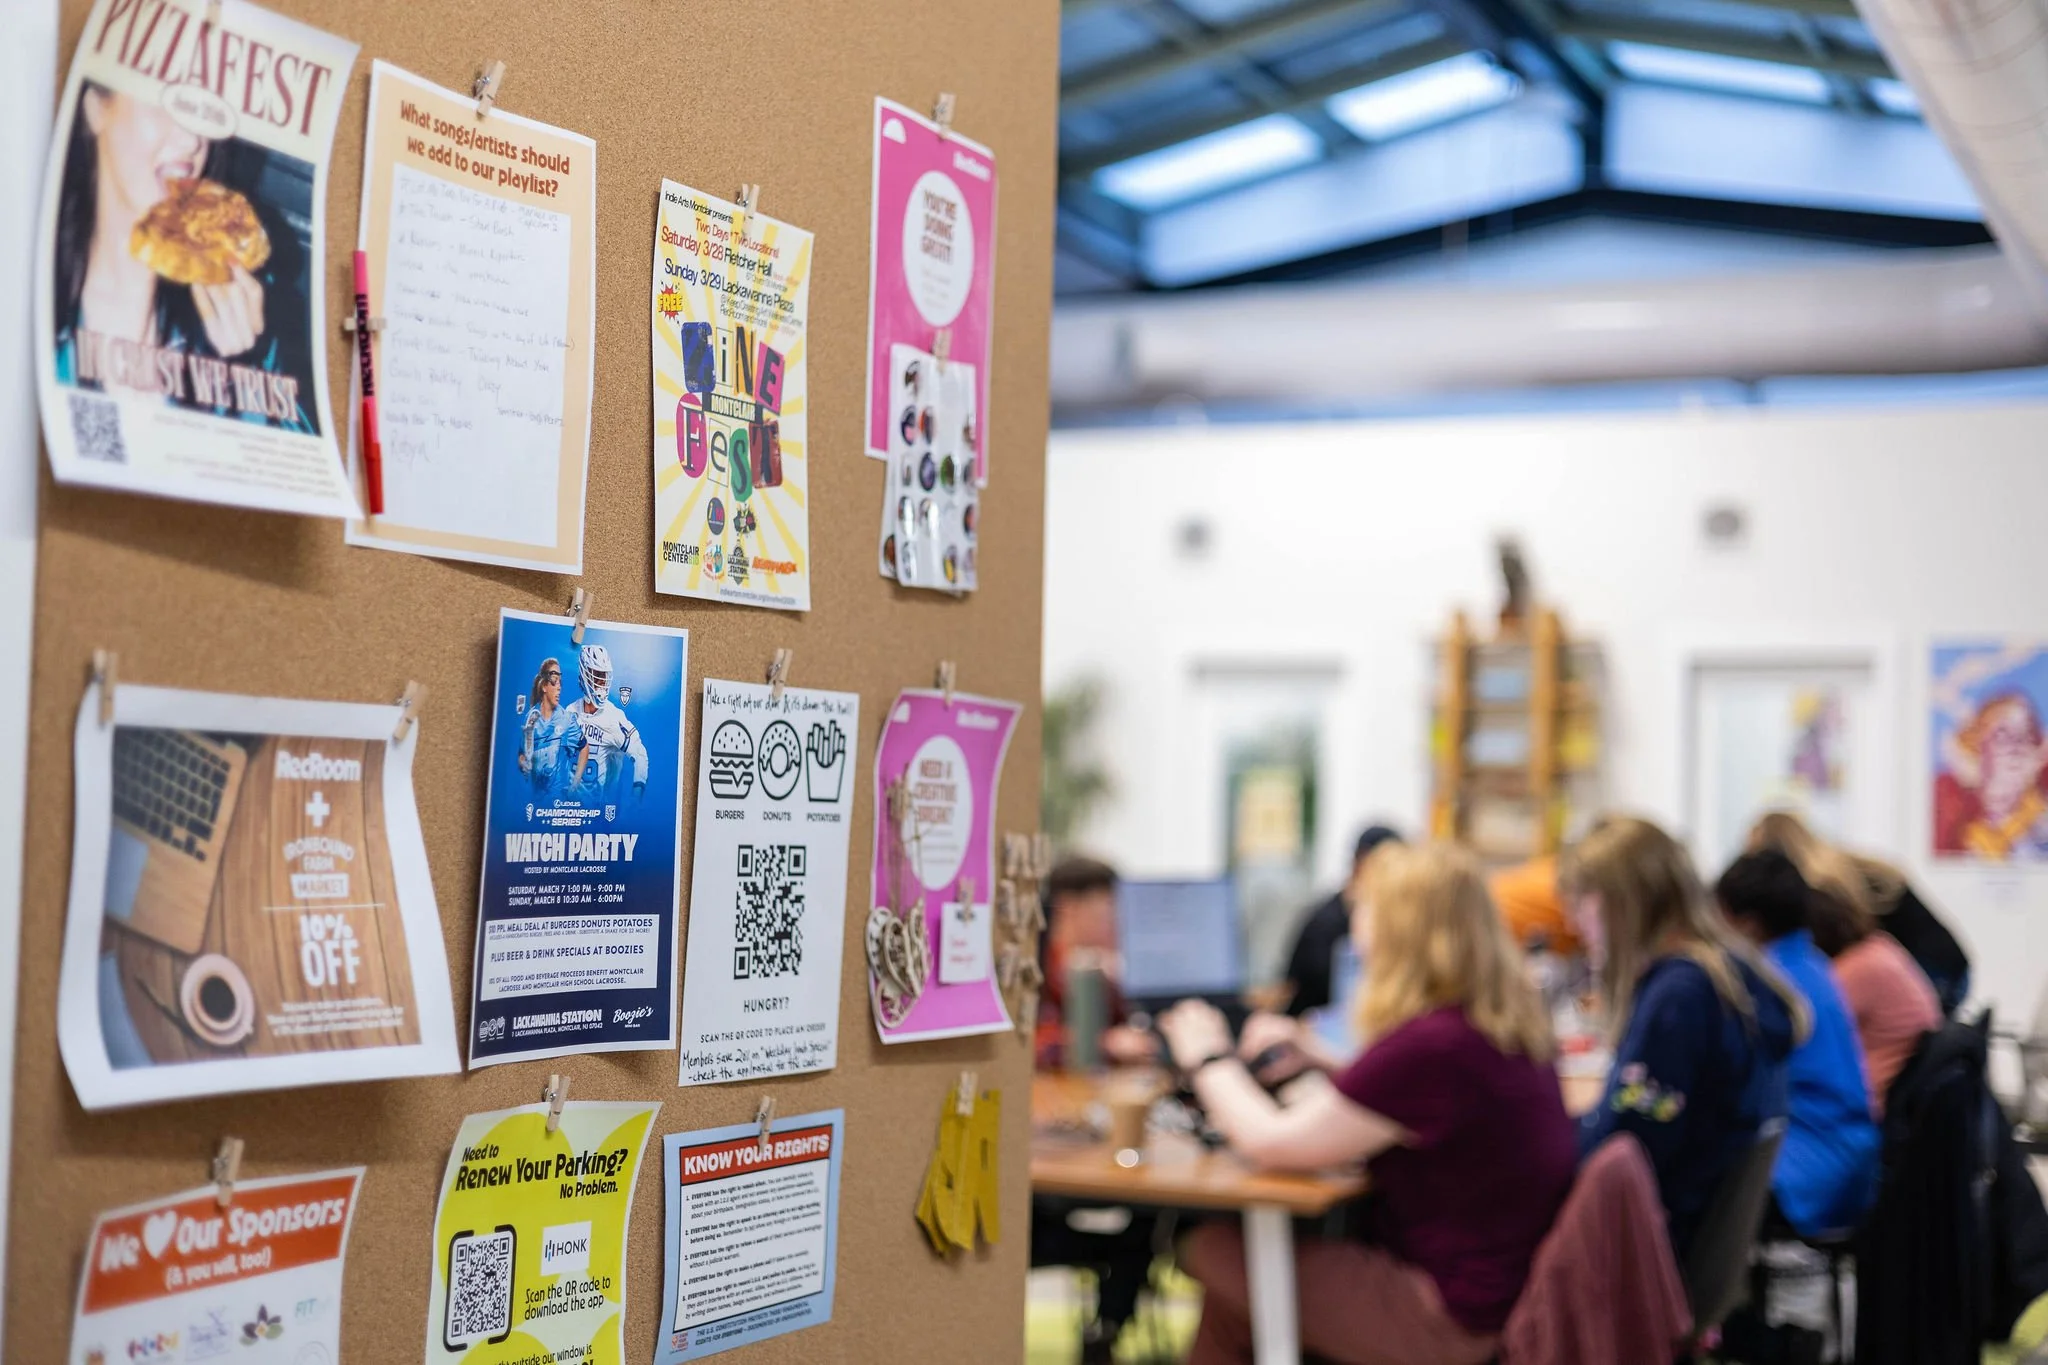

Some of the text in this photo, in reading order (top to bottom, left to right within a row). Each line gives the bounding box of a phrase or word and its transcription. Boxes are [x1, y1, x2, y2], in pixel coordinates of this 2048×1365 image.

[94, 0, 332, 136] PIZZAFEST
[401, 100, 570, 175] What songs/artists should
[408, 136, 425, 156] we
[428, 145, 452, 167] add
[455, 152, 468, 172] to
[472, 160, 495, 182] our
[499, 167, 558, 198] playlist?
[696, 218, 710, 235] Two
[712, 224, 729, 241] Days
[661, 226, 701, 257] Saturday
[703, 240, 724, 261] 3/28
[665, 258, 699, 286] Sunday
[701, 269, 721, 290] 3/29
[657, 293, 683, 313] FREE
[188, 353, 231, 407] WE
[229, 361, 300, 422] TRUST
[711, 395, 757, 421] MONTCLAIR
[663, 541, 700, 557] MONTCLAIR
[536, 809, 600, 818] CHAMPIONSHIP
[551, 818, 582, 827] SERIES
[715, 809, 842, 823] BURGERS DONUTS POTATOES
[505, 833, 639, 863] WATCH PARTY
[550, 866, 579, 874] MONTCLAIR
[508, 884, 626, 896] SATURDAY, MARCH 7 1:00 PM 9:00 PM
[509, 895, 623, 906] SUNDAY, MARCH 8 10:30 AM 6:00PM
[300, 913, 354, 941] 10%
[507, 923, 523, 932] MEAL
[524, 922, 540, 931] DEAL
[541, 921, 549, 930] AT
[550, 920, 580, 930] BURGERS
[581, 919, 611, 929] DONUTS
[612, 918, 653, 927] POTATOES
[301, 938, 360, 988] OFF
[491, 945, 644, 962] PLUS BEER & DRINK SPECIALS AT BOOZIES
[499, 984, 521, 993] LACROSSE
[533, 981, 559, 989] MONTCLAIR
[595, 977, 627, 985] LACROSSE.
[536, 972, 559, 980] BEVERAGE
[560, 970, 585, 978] PROCEEDS
[586, 969, 608, 977] BENEFIT
[612, 1005, 655, 1024] Boozie's
[743, 997, 790, 1013] HUNGRY?
[513, 1009, 603, 1030] LACKAWANNA STATION
[700, 1034, 720, 1044] SCAN
[721, 1032, 734, 1041] THE
[735, 1031, 745, 1040] QR
[746, 1029, 763, 1039] CODE
[764, 1028, 774, 1037] TO
[774, 1026, 794, 1036] PLACE
[462, 1144, 499, 1163] Need to
[684, 1134, 830, 1176] KNOW YOUR RIGHTS
[455, 1148, 628, 1192] Renew Your Parking?
[560, 1178, 618, 1199] No Problem.
[100, 1198, 345, 1272] We Our Sponsors
[556, 1238, 587, 1256] HONK
[186, 1263, 211, 1286] you
[525, 1276, 611, 1304] Scan the QR code to
[524, 1294, 604, 1321] download the app
[542, 1343, 593, 1365] our window is
